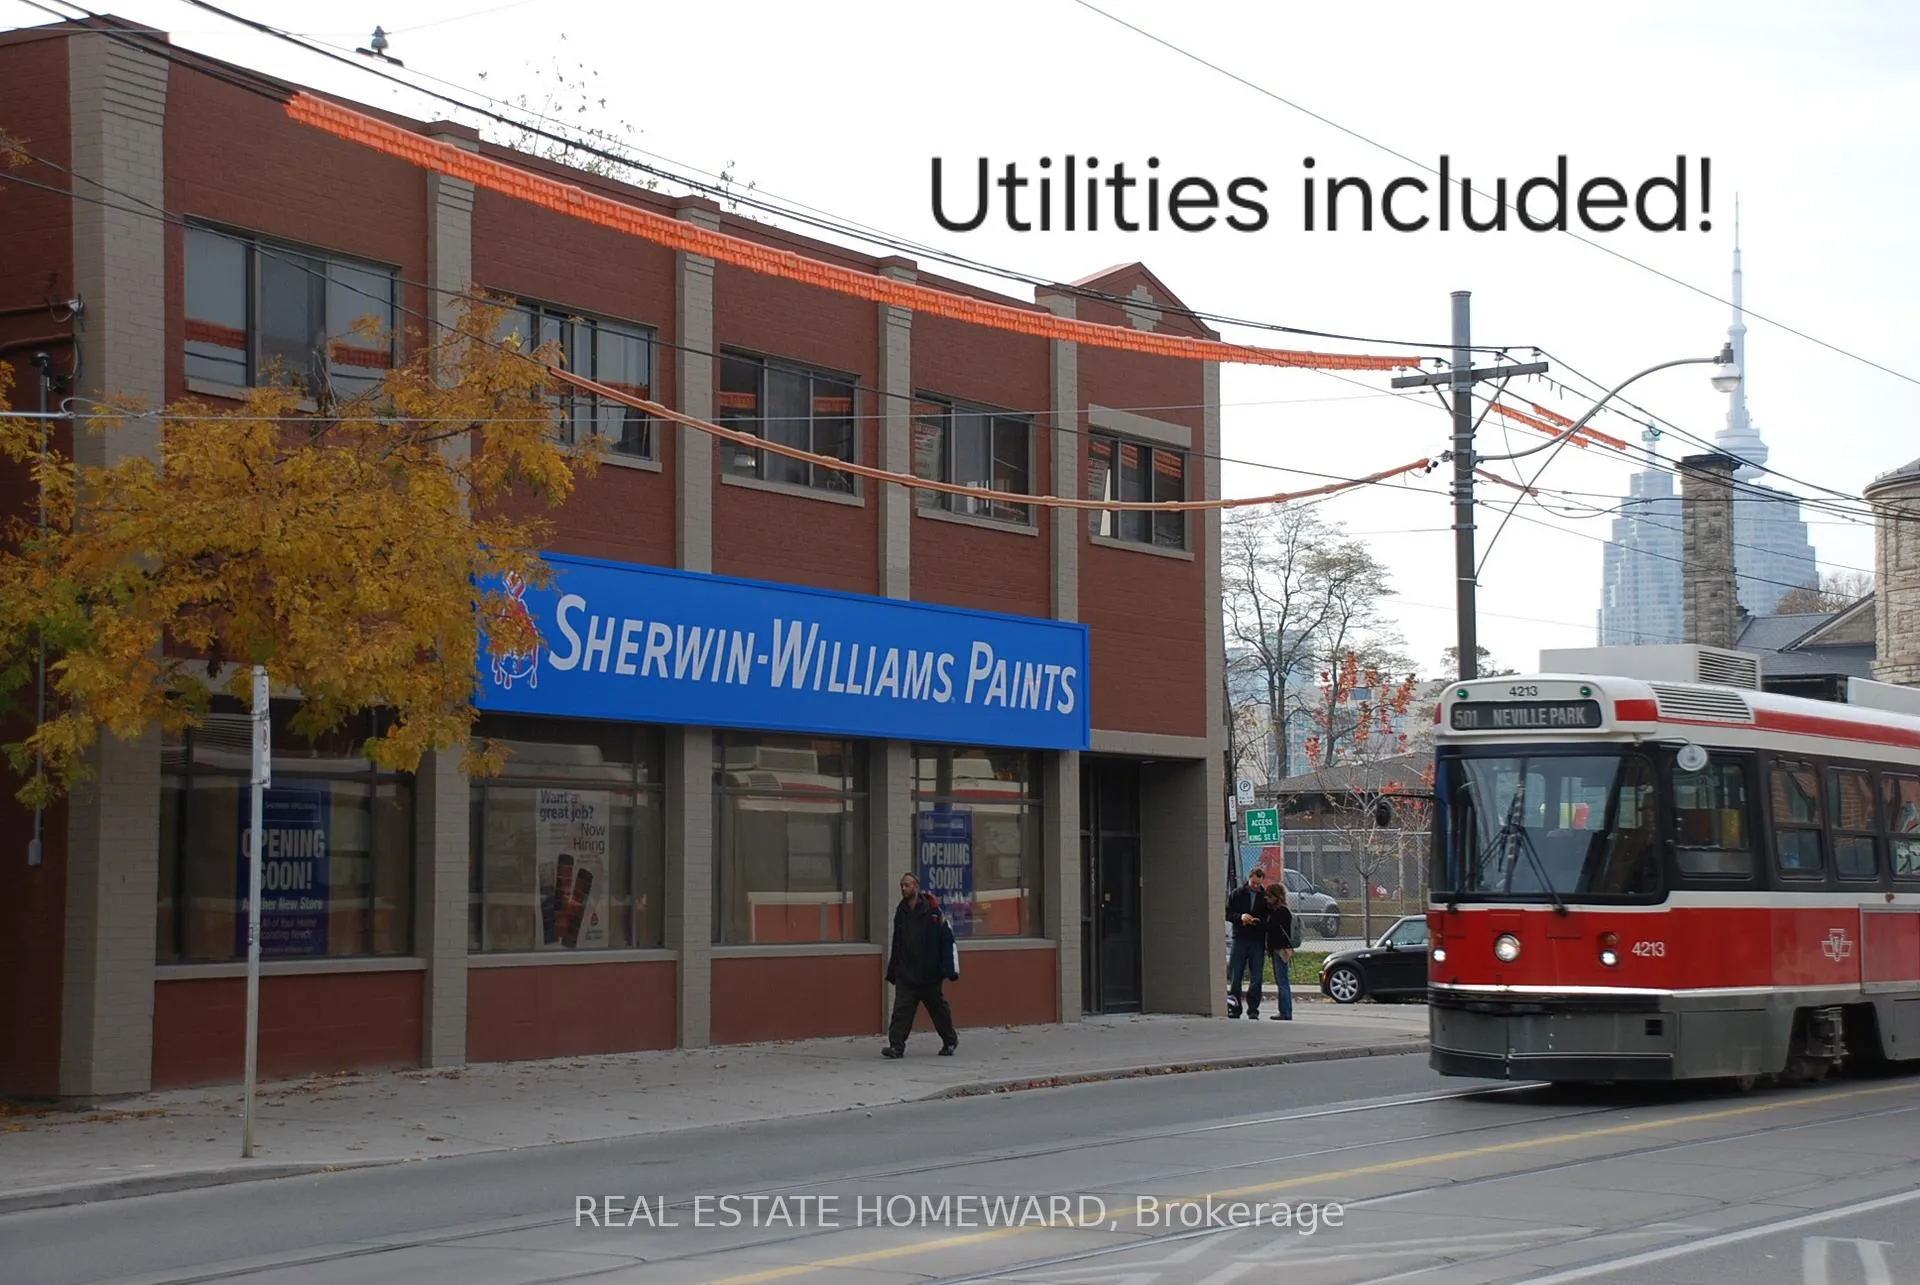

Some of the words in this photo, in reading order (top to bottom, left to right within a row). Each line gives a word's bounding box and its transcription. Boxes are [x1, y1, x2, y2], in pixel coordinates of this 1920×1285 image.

[549, 594, 953, 703] SHERWIN-WILLIAMS
[965, 641, 1077, 714] PAINTS
[1509, 685, 1538, 697] 4213
[1454, 710, 1478, 727] 501
[1492, 707, 1547, 726] NEVILLE
[1550, 706, 1586, 725] PARK
[540, 790, 569, 804] Want
[571, 793, 578, 804] a
[539, 805, 569, 822] great
[571, 804, 594, 822] job?
[1257, 811, 1266, 819] NO
[581, 823, 606, 837] Now
[1251, 818, 1273, 826] ACCESS
[242, 828, 325, 858] OPENING
[573, 837, 605, 855] Hiring
[922, 842, 970, 865] OPENING
[928, 867, 963, 889] SOON!
[242, 897, 277, 911] Aher
[279, 897, 298, 910] New
[299, 896, 323, 910] Store
[1631, 941, 1665, 957] 4213
